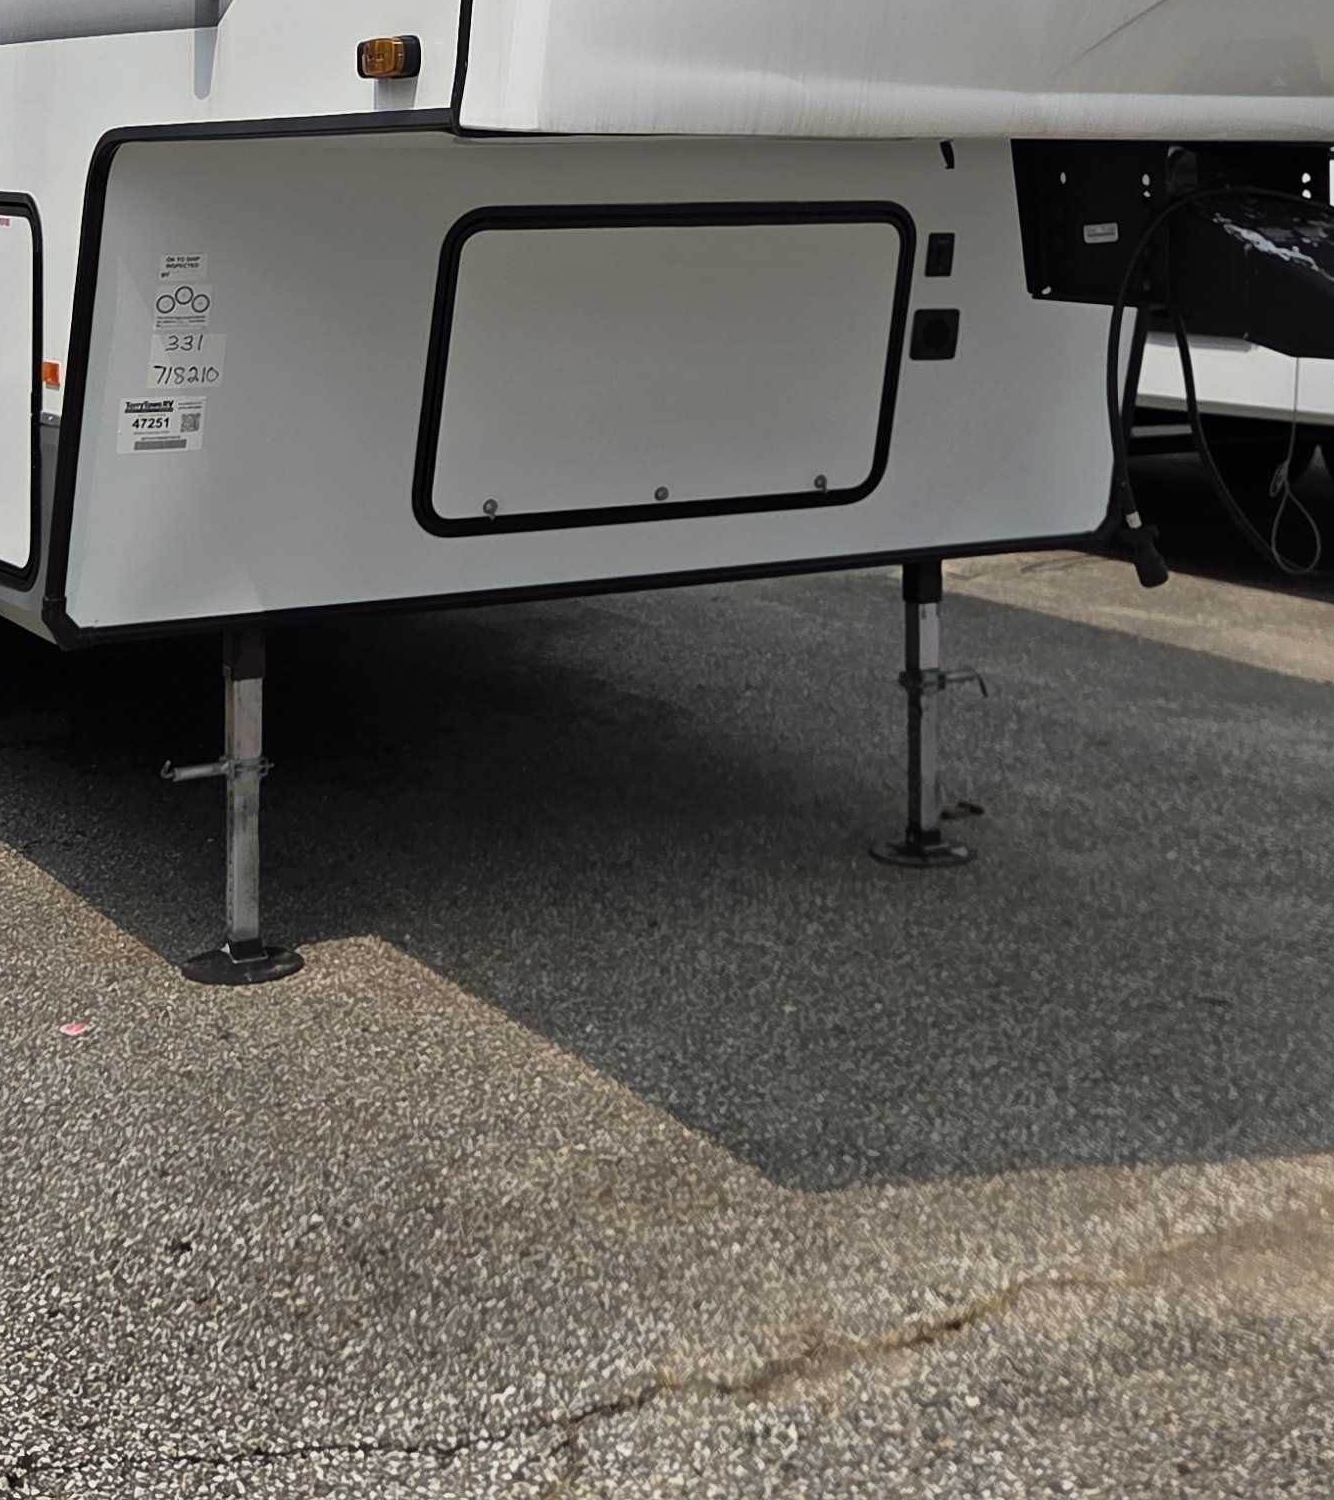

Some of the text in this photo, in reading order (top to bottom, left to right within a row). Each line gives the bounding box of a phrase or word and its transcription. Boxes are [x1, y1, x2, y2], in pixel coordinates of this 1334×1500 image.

[164, 333, 204, 352] 331
[153, 364, 220, 385] 718210
[131, 417, 170, 429] 47251
